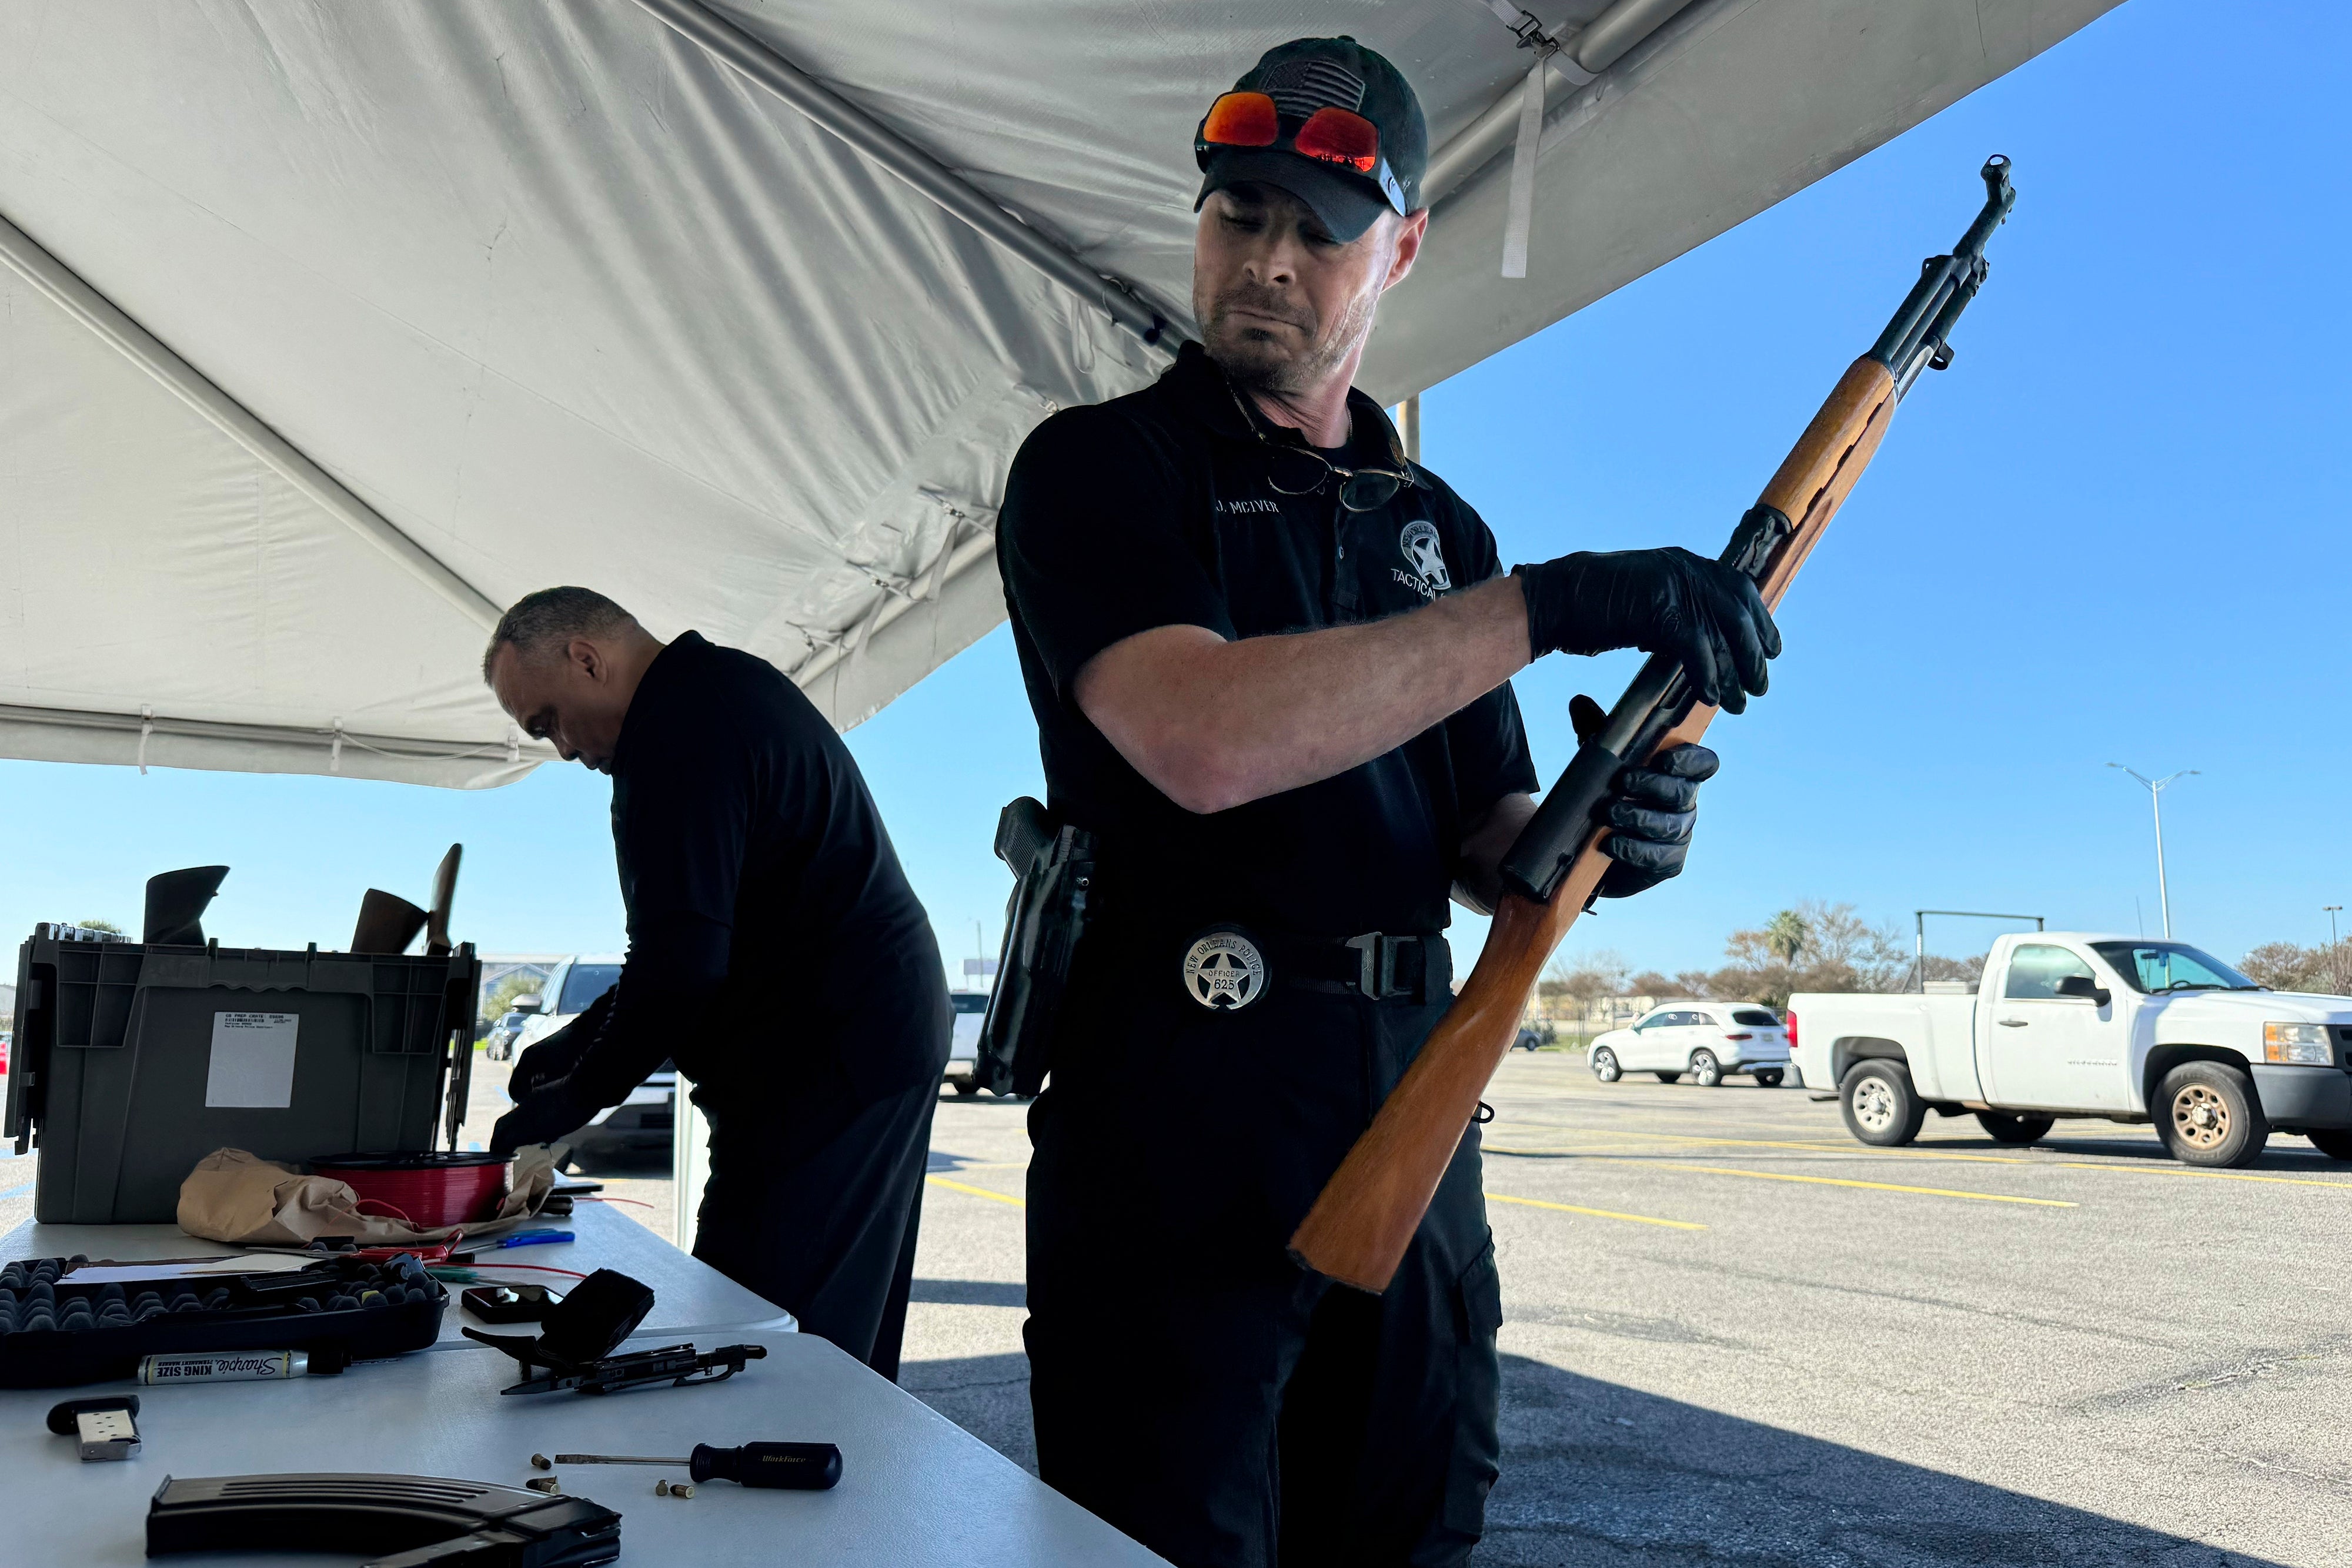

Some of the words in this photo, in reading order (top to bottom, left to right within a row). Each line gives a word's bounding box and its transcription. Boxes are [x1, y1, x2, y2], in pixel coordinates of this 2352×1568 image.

[1215, 500, 1227, 512] J.
[1229, 500, 1280, 514] MCIVER
[1185, 954, 1199, 974] NEW
[1197, 938, 1237, 955] ORLEANS
[1238, 945, 1261, 976] POLICE
[1214, 978, 1235, 990] 625
[156, 1366, 181, 1378] SIZE
[183, 1365, 212, 1376] KING
[216, 1356, 282, 1375] Sharpie
